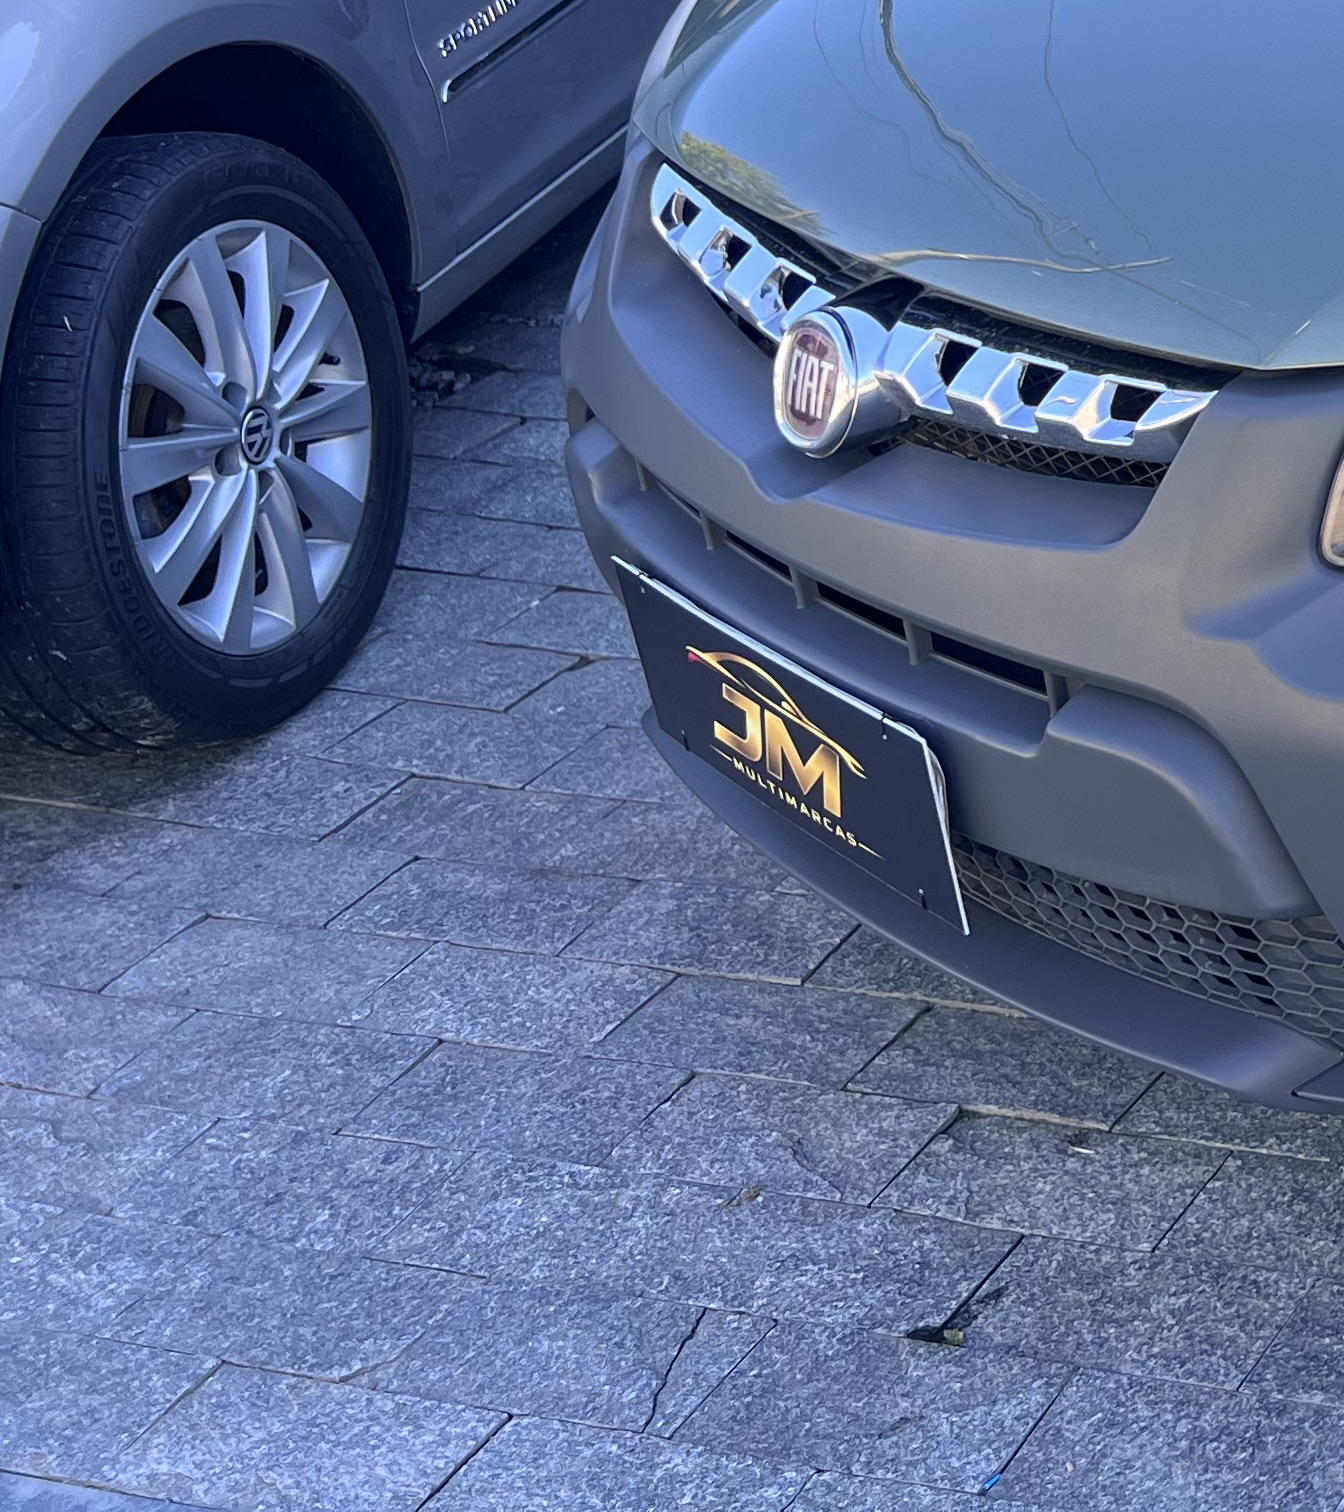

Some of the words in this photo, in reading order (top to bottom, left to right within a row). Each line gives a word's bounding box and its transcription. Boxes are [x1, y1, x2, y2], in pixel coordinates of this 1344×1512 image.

[786, 347, 835, 420] FIAT
[713, 682, 842, 818] JM
[732, 756, 857, 847] MULTIMARCAS
